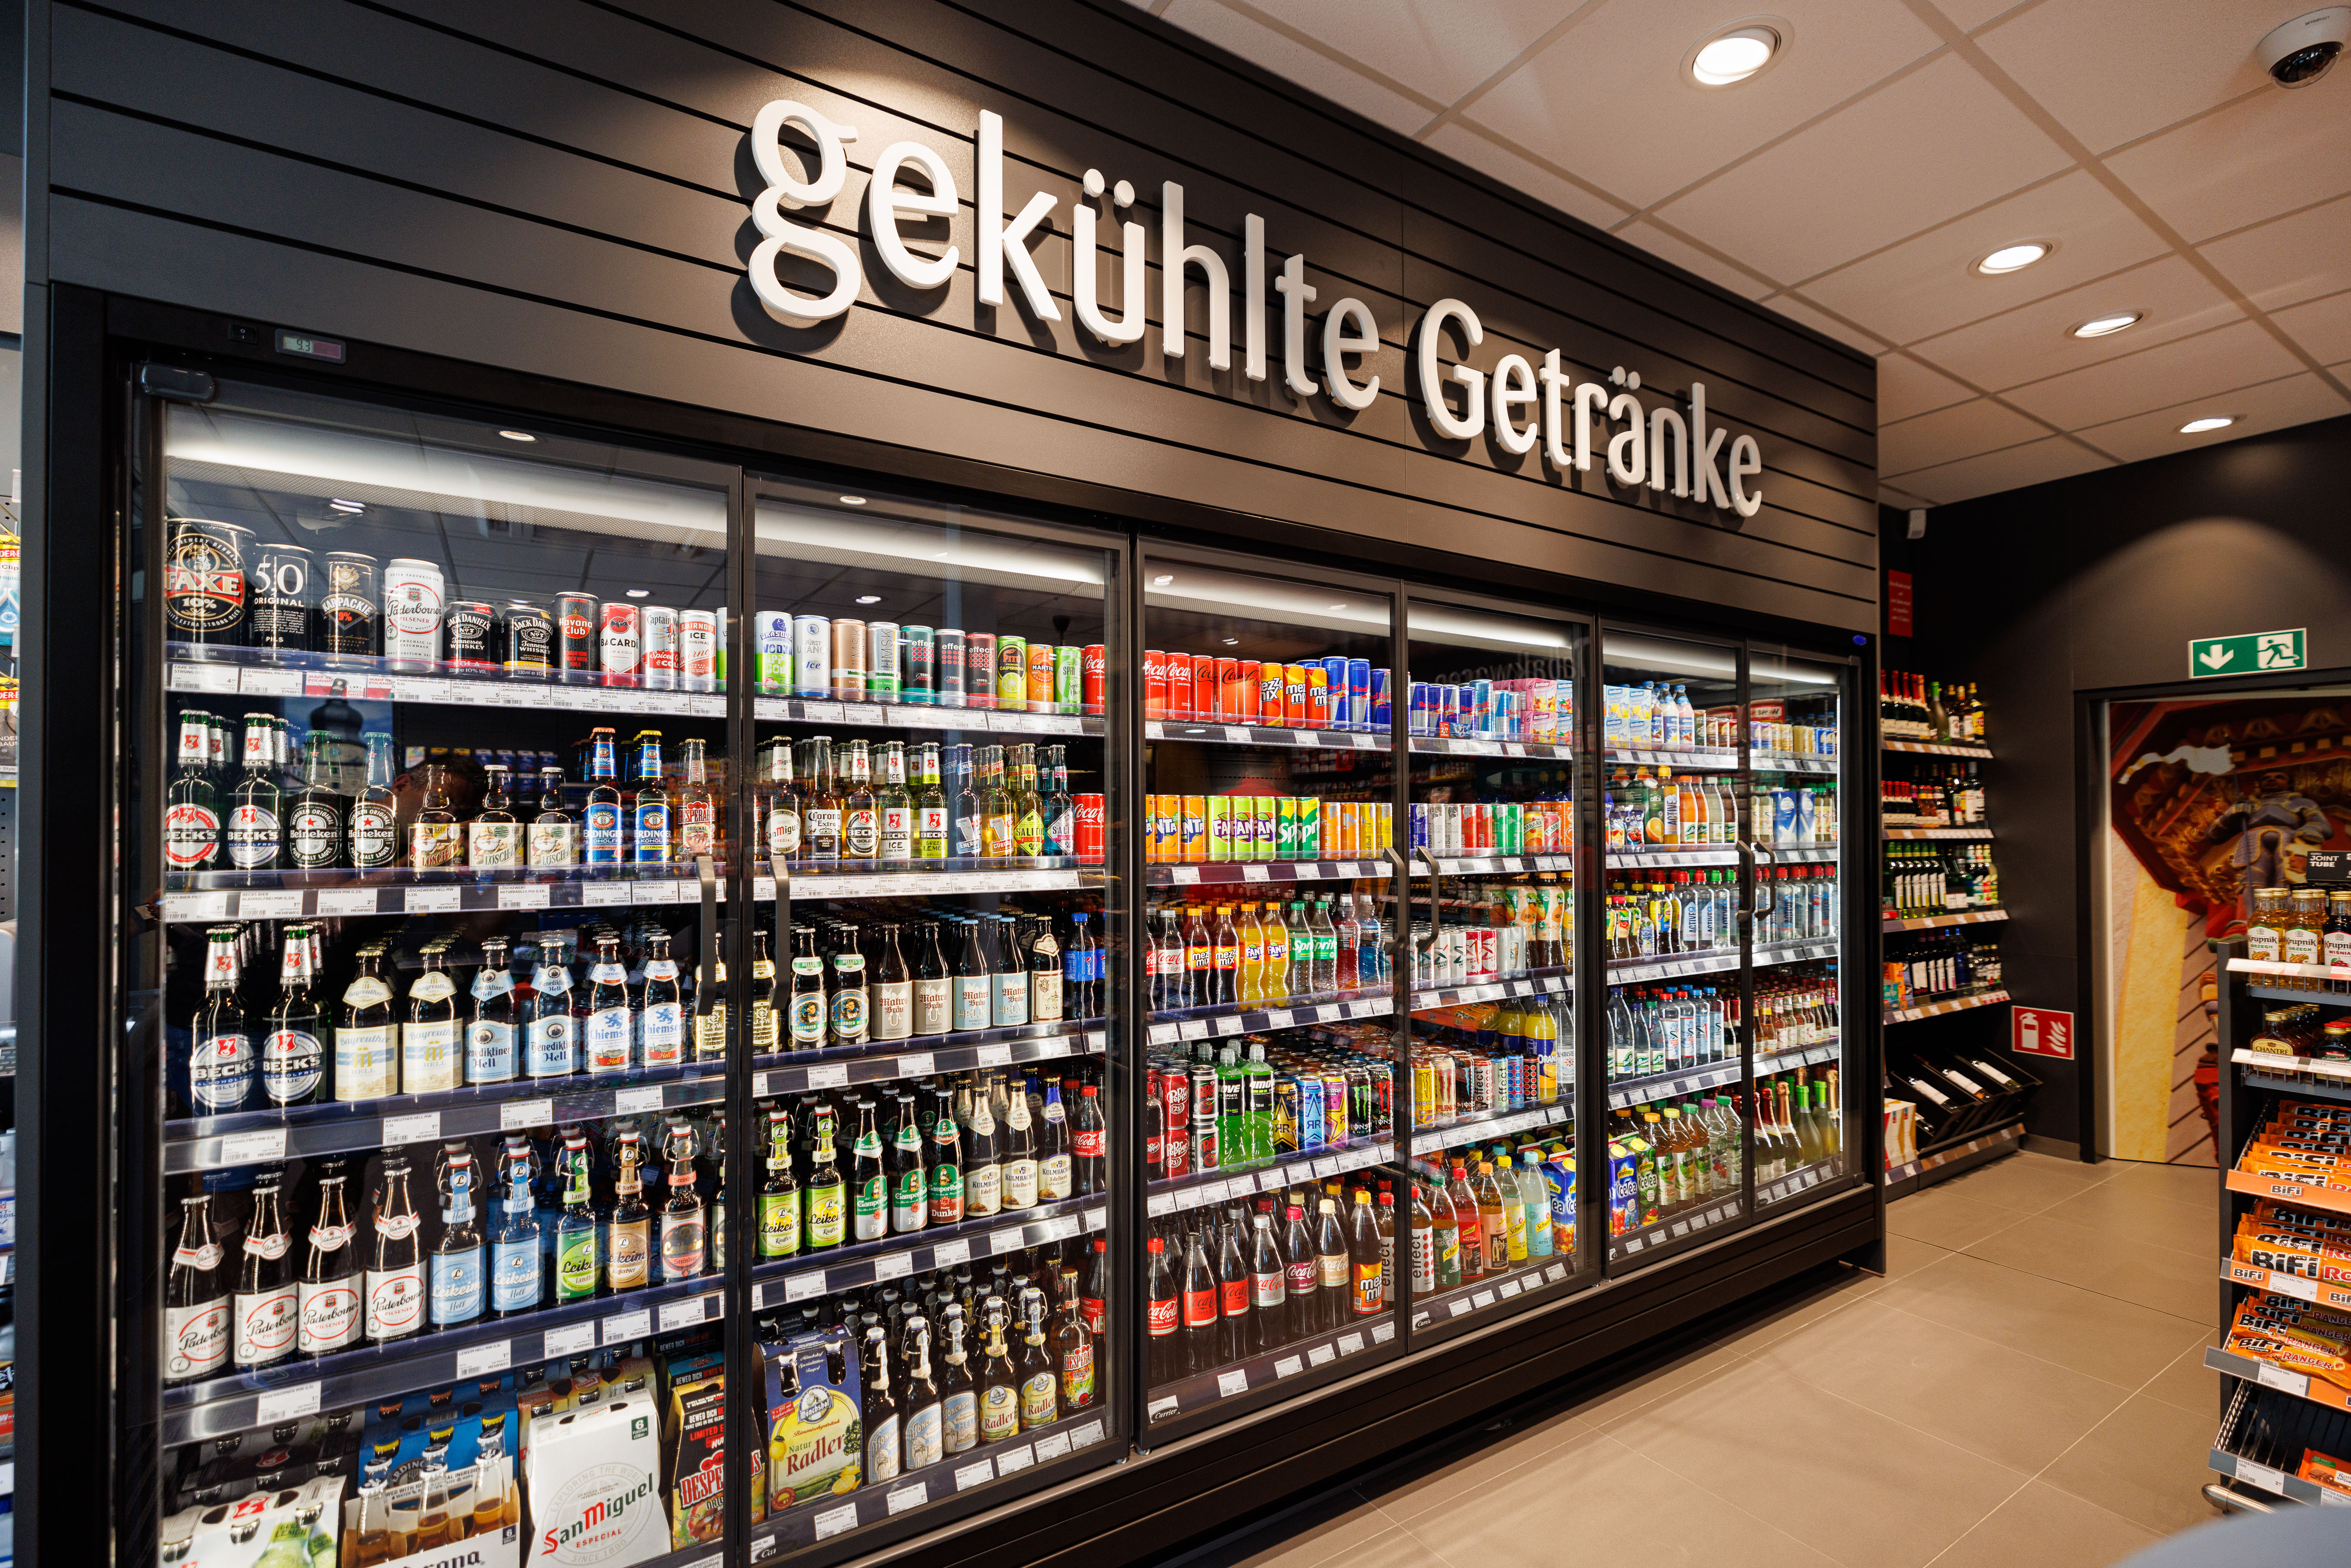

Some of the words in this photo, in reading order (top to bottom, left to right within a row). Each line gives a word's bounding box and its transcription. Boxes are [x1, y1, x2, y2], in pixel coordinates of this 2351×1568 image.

[748, 98, 1381, 409] gekühlte
[1419, 298, 1762, 519] Getränke
[166, 572, 239, 596] FAXE
[182, 598, 217, 609] 10%
[254, 598, 304, 607] ORIGINAL
[322, 596, 372, 617] KARPACKIE
[387, 599, 442, 617] Paderborner
[180, 618, 199, 627] EXTRA
[203, 619, 228, 627] STRONG
[229, 609, 240, 620] BEER
[339, 612, 352, 621] 9%
[447, 616, 459, 627] JACK
[559, 617, 593, 627] Havana
[647, 615, 671, 625] Captain
[514, 619, 530, 631] JACK
[564, 626, 585, 635] Club
[681, 622, 714, 632] SMIRNOFF
[521, 641, 550, 649] Tennessee
[601, 638, 639, 648] BACARDÍ
[881, 629, 893, 659] MSK
[912, 640, 934, 648] effect
[941, 643, 965, 651] effect
[650, 651, 674, 660] Spiced
[1003, 654, 1021, 663] PITÚ
[806, 660, 821, 669] Ice
[292, 809, 310, 825] HEINEKEN
[311, 809, 334, 825] ORIGINAL
[808, 812, 841, 822] Corona
[228, 830, 278, 841] BECK'S
[290, 830, 338, 838] Heineken
[960, 841, 979, 849] ENERGY
[292, 847, 301, 857] PURE
[318, 847, 333, 858] LAGER
[2249, 935, 2277, 944] Krupnik
[2286, 937, 2316, 947] Krupnik
[962, 991, 989, 1000] Mahrs
[879, 998, 908, 1008] Mahrs
[885, 1006, 904, 1014] Bräu
[409, 1028, 459, 1040] Bayreuther
[340, 1035, 391, 1047] Bayreuther
[531, 1038, 578, 1053] Benediktiner
[465, 1046, 511, 1059] Benediktiner
[543, 1048, 567, 1062] Hell
[2255, 1046, 2289, 1055] CHANTRÉ
[263, 1056, 320, 1072] BECK'S
[473, 1057, 496, 1069] Hell
[195, 1059, 255, 1079] BECK'S
[215, 1082, 242, 1090] BLUE
[1005, 1172, 1037, 1181] KULMBACHER
[928, 1183, 963, 1192] Gampertbräu
[2271, 1185, 2302, 1195] BiFi
[932, 1207, 959, 1217] Dunkel
[761, 1219, 801, 1234] Leikeim
[775, 1235, 792, 1244] Radler
[674, 1256, 698, 1265] Steinbier
[2251, 1249, 2321, 1278] BiFi
[431, 1281, 483, 1299] Leikeim
[385, 1305, 413, 1316] PILSENER
[450, 1300, 466, 1312] Hell
[304, 1301, 359, 1325] Paderborner
[2282, 1351, 2333, 1370] RANGER
[800, 1398, 831, 1418] Mönchshof
[1154, 1408, 1176, 1419] Carrier
[689, 1412, 706, 1423] BEWEG
[707, 1410, 717, 1419] DICH
[984, 1411, 1014, 1429] Radler
[636, 1420, 644, 1430] 6
[793, 1419, 840, 1437] Biermischgetränk
[690, 1427, 718, 1441] LIMITED
[789, 1441, 812, 1454] Natur
[786, 1433, 845, 1477] Radler
[2251, 1463, 2275, 1475] KNUSPERKEKS
[888, 1491, 905, 1499] MÖNCHSHOF
[576, 1528, 622, 1549] ESPECIAL
